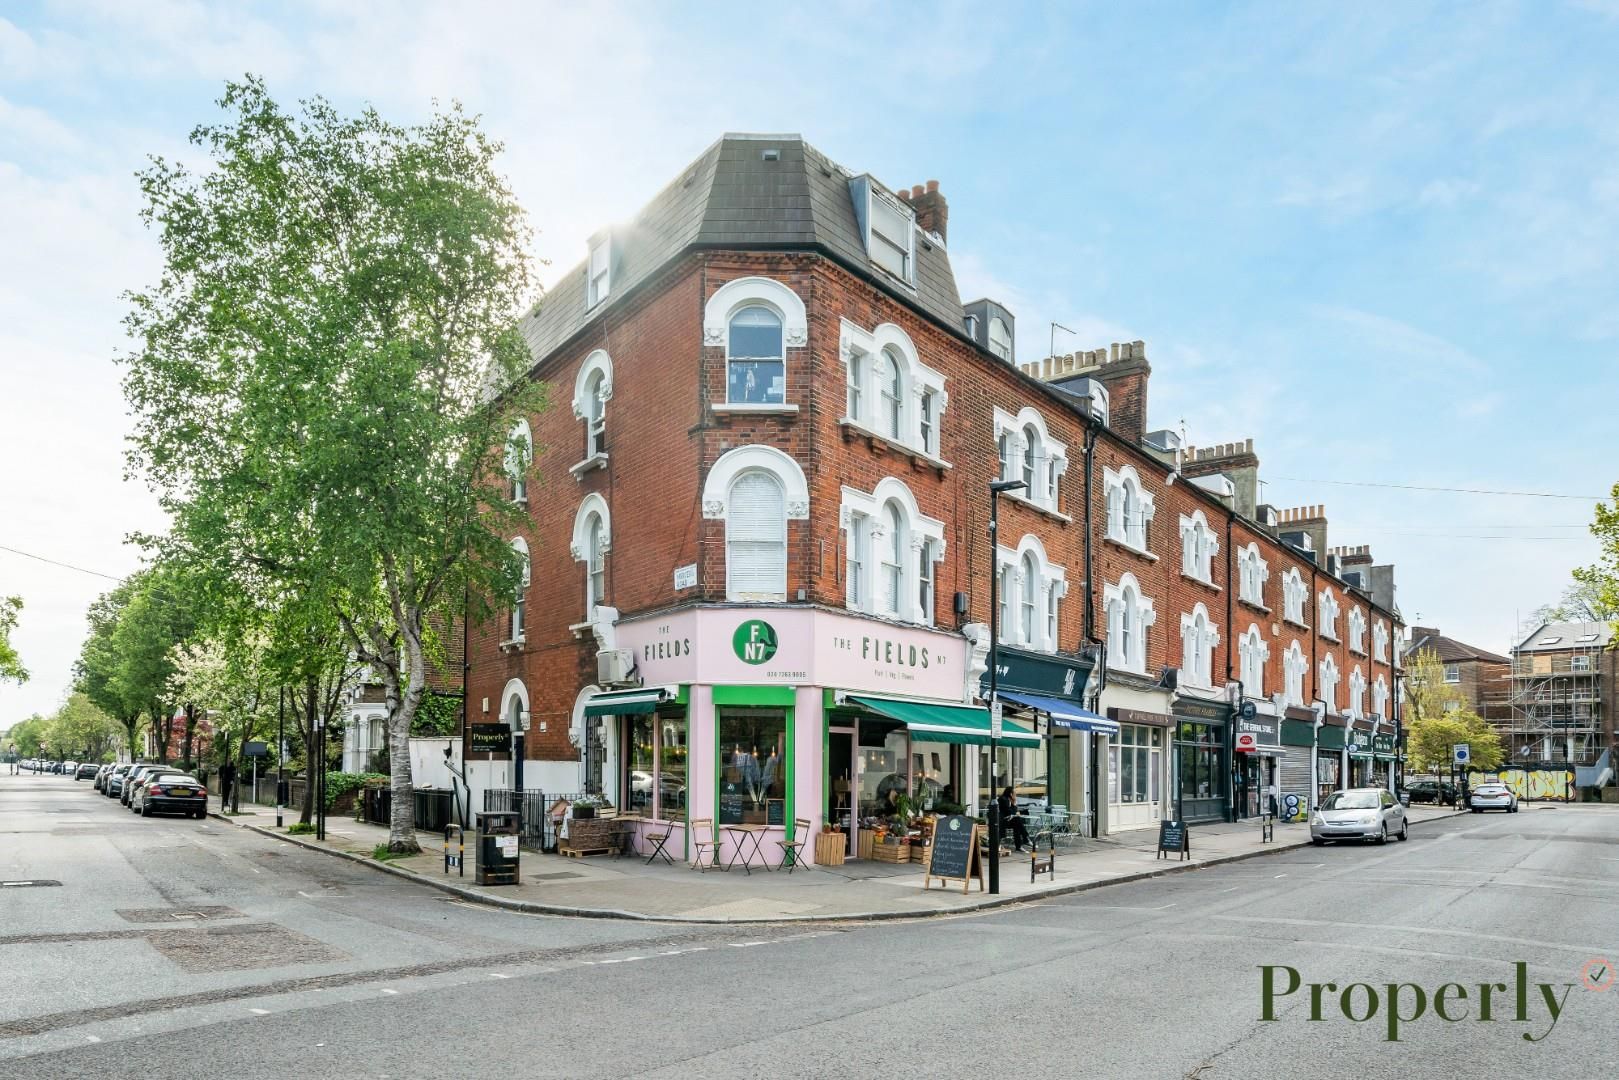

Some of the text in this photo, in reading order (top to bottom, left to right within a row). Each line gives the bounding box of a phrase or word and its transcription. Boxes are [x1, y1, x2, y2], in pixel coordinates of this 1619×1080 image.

[750, 624, 760, 642] F
[644, 638, 690, 662] FIELDS
[744, 642, 765, 660] N7
[833, 637, 852, 650] THE
[862, 636, 929, 669] FIELDS
[473, 733, 505, 743] Properly
